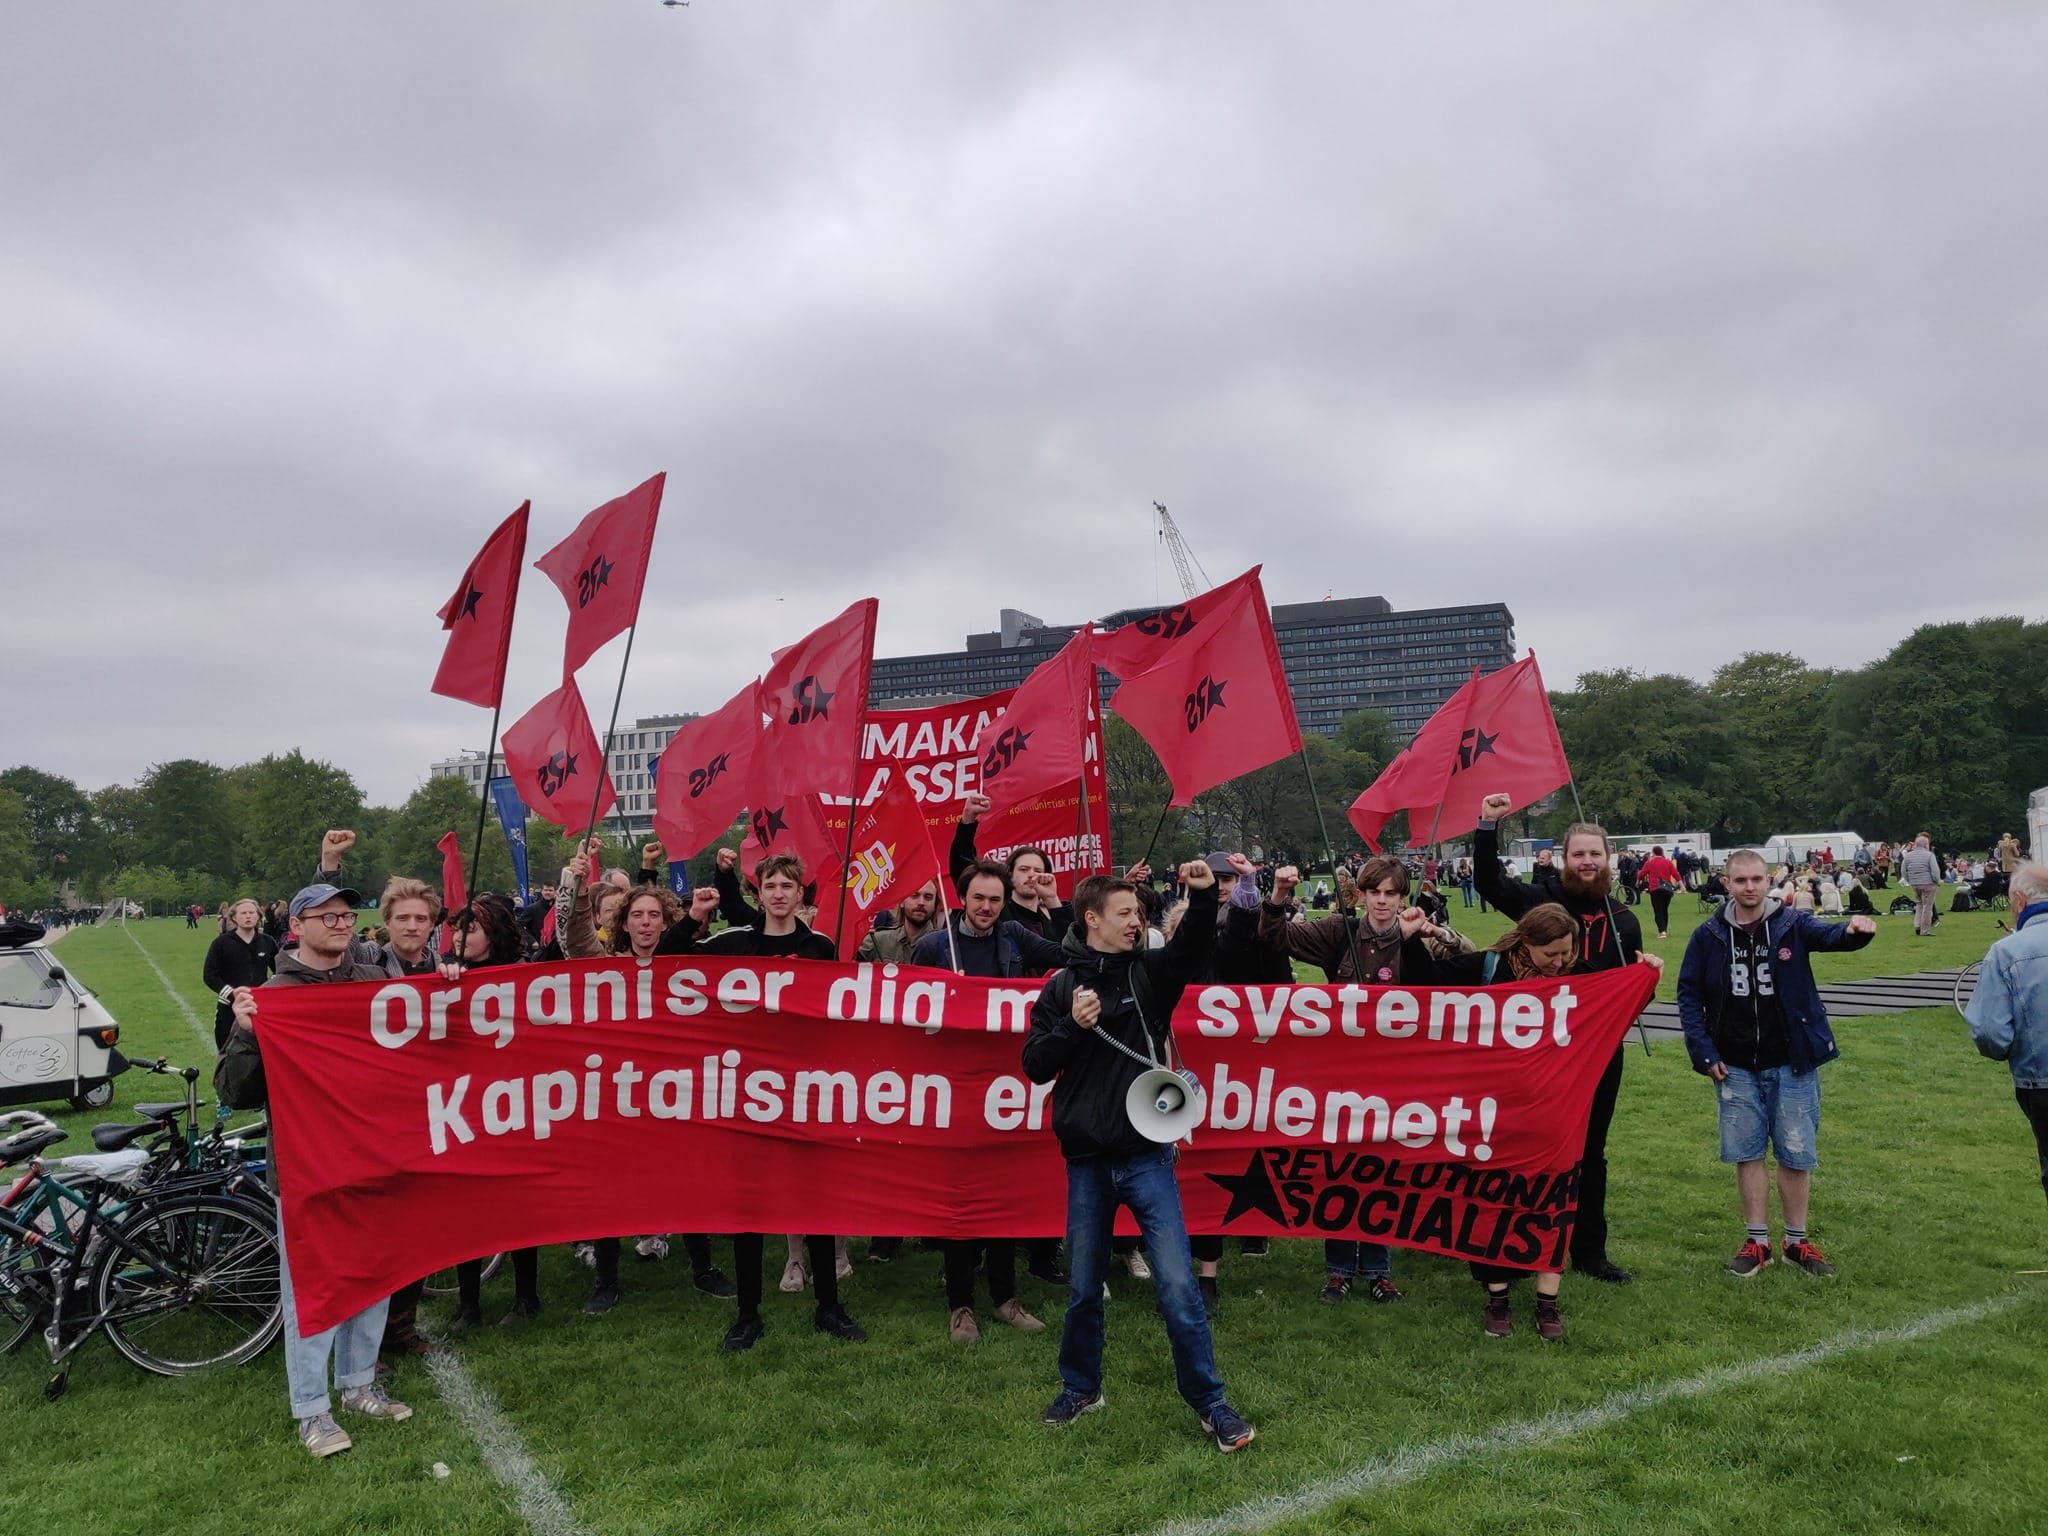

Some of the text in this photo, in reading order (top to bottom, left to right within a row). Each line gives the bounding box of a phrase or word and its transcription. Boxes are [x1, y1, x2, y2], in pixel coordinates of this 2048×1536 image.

[370, 957, 795, 1049] Organiser
[826, 963, 947, 1035] dig
[1196, 983, 1579, 1049] systemet
[425, 1049, 952, 1156] Kapitalismen
[1192, 1062, 1498, 1162] blemet!
